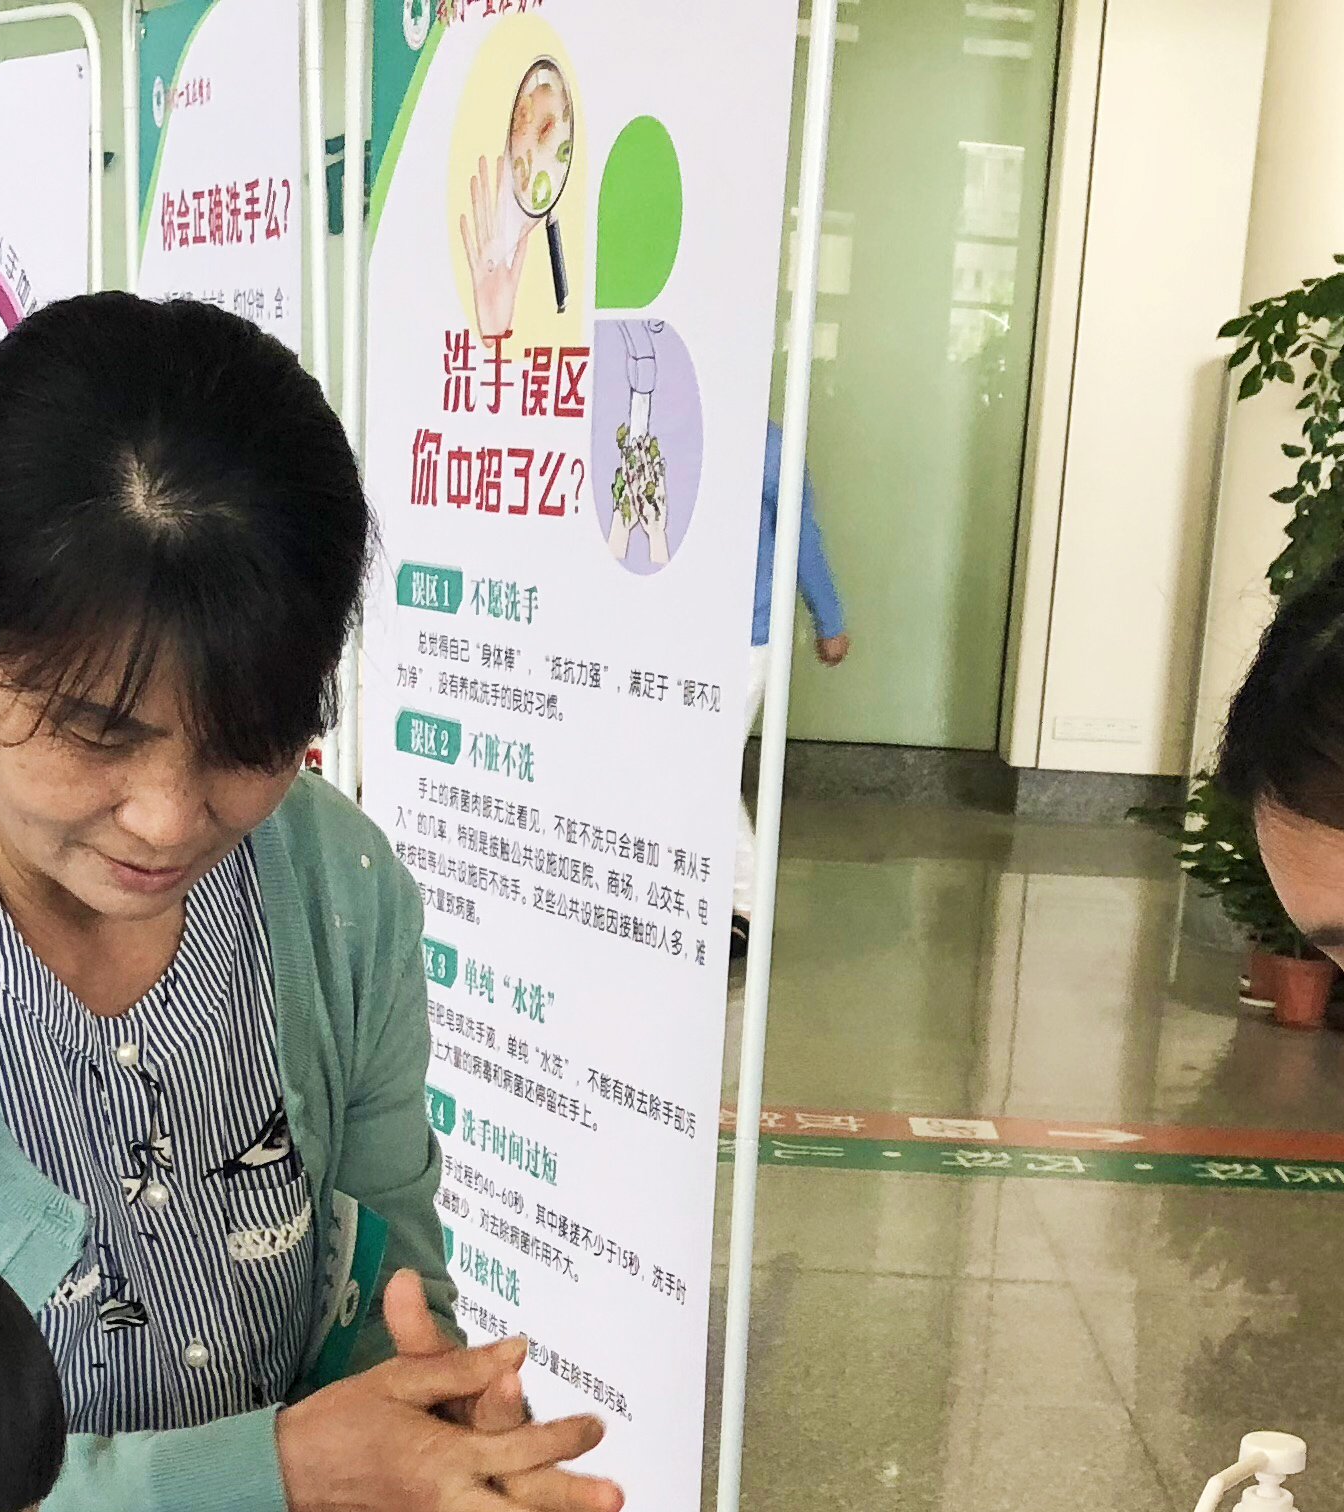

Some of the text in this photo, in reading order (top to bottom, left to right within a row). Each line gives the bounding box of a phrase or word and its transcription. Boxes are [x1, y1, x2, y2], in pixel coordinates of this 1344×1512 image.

[442, 329, 592, 420] 洗手误区
[470, 578, 539, 626] 不愿洗手
[468, 731, 536, 784] 不脏不洗
[464, 957, 556, 1024] 单纯“水洗”
[429, 1033, 598, 1132] 上大量的病毒和病菌还停留在手上。
[461, 1108, 559, 1187] 洗手时间过短
[459, 1241, 521, 1307] 以擦代洗
